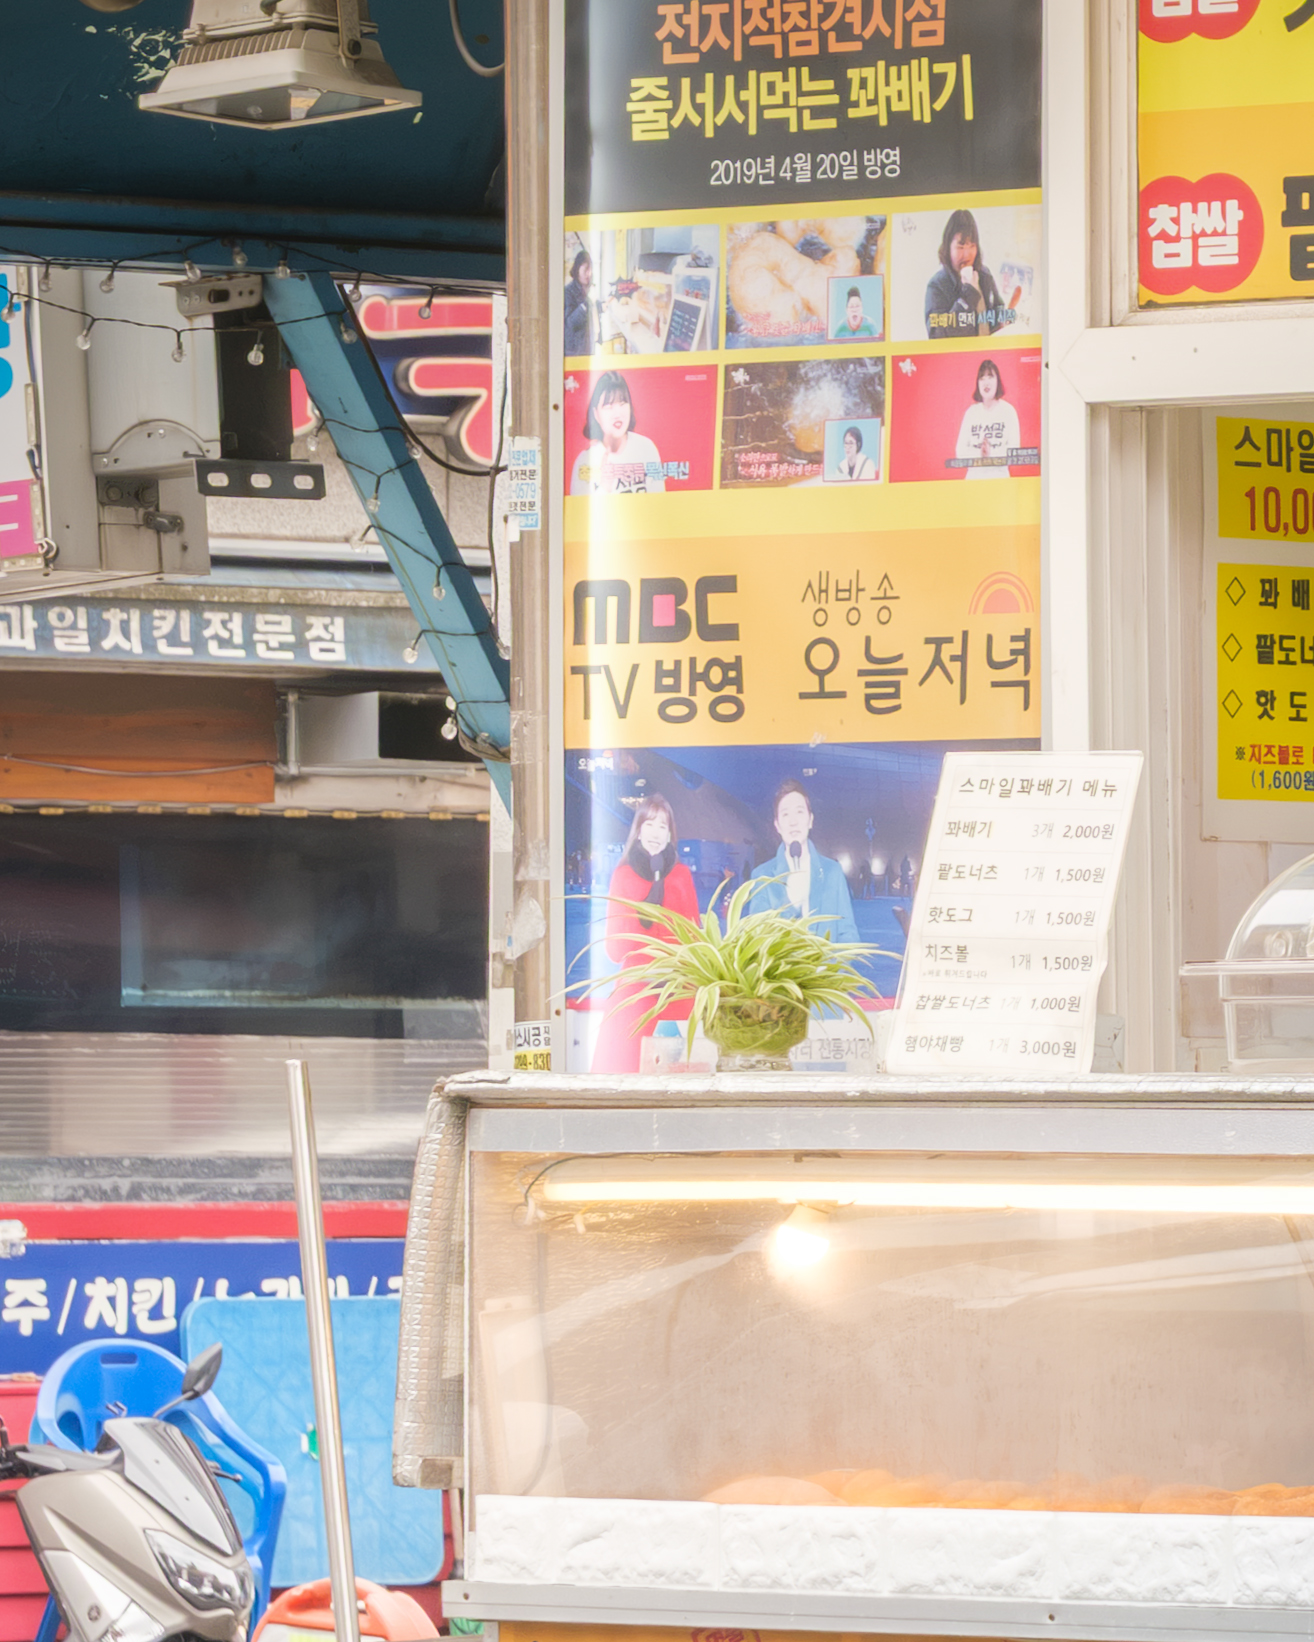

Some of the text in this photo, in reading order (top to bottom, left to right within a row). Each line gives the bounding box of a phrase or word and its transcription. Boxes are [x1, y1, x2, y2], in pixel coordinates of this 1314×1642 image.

[656, 0, 946, 65] 전지적참견시점
[626, 54, 975, 142] 줄서서먹는 꽈배기
[709, 146, 902, 186] 2019년 4월 20일 방영
[1147, 199, 1245, 271] 찹쌀
[957, 311, 976, 327] 먼저
[571, 573, 741, 646] MBC
[800, 569, 901, 627] 생방송
[570, 655, 746, 724] TV 방영
[958, 777, 1119, 799] 스마일꽈배기 메뉴
[944, 820, 1116, 841] 꽈배기 3개 2,000원
[937, 863, 1107, 885] 팥도너츠 1개 1,500원
[927, 906, 1097, 928] 핫도그 1개 1,500원
[924, 943, 1094, 973] 치즈볼 1개 1,500원
[914, 994, 993, 1012] 찹쌀도너츠
[1029, 996, 1083, 1013] 1,000원
[904, 1034, 965, 1054] 햄야채빵
[1019, 1039, 1078, 1059] 3,000원
